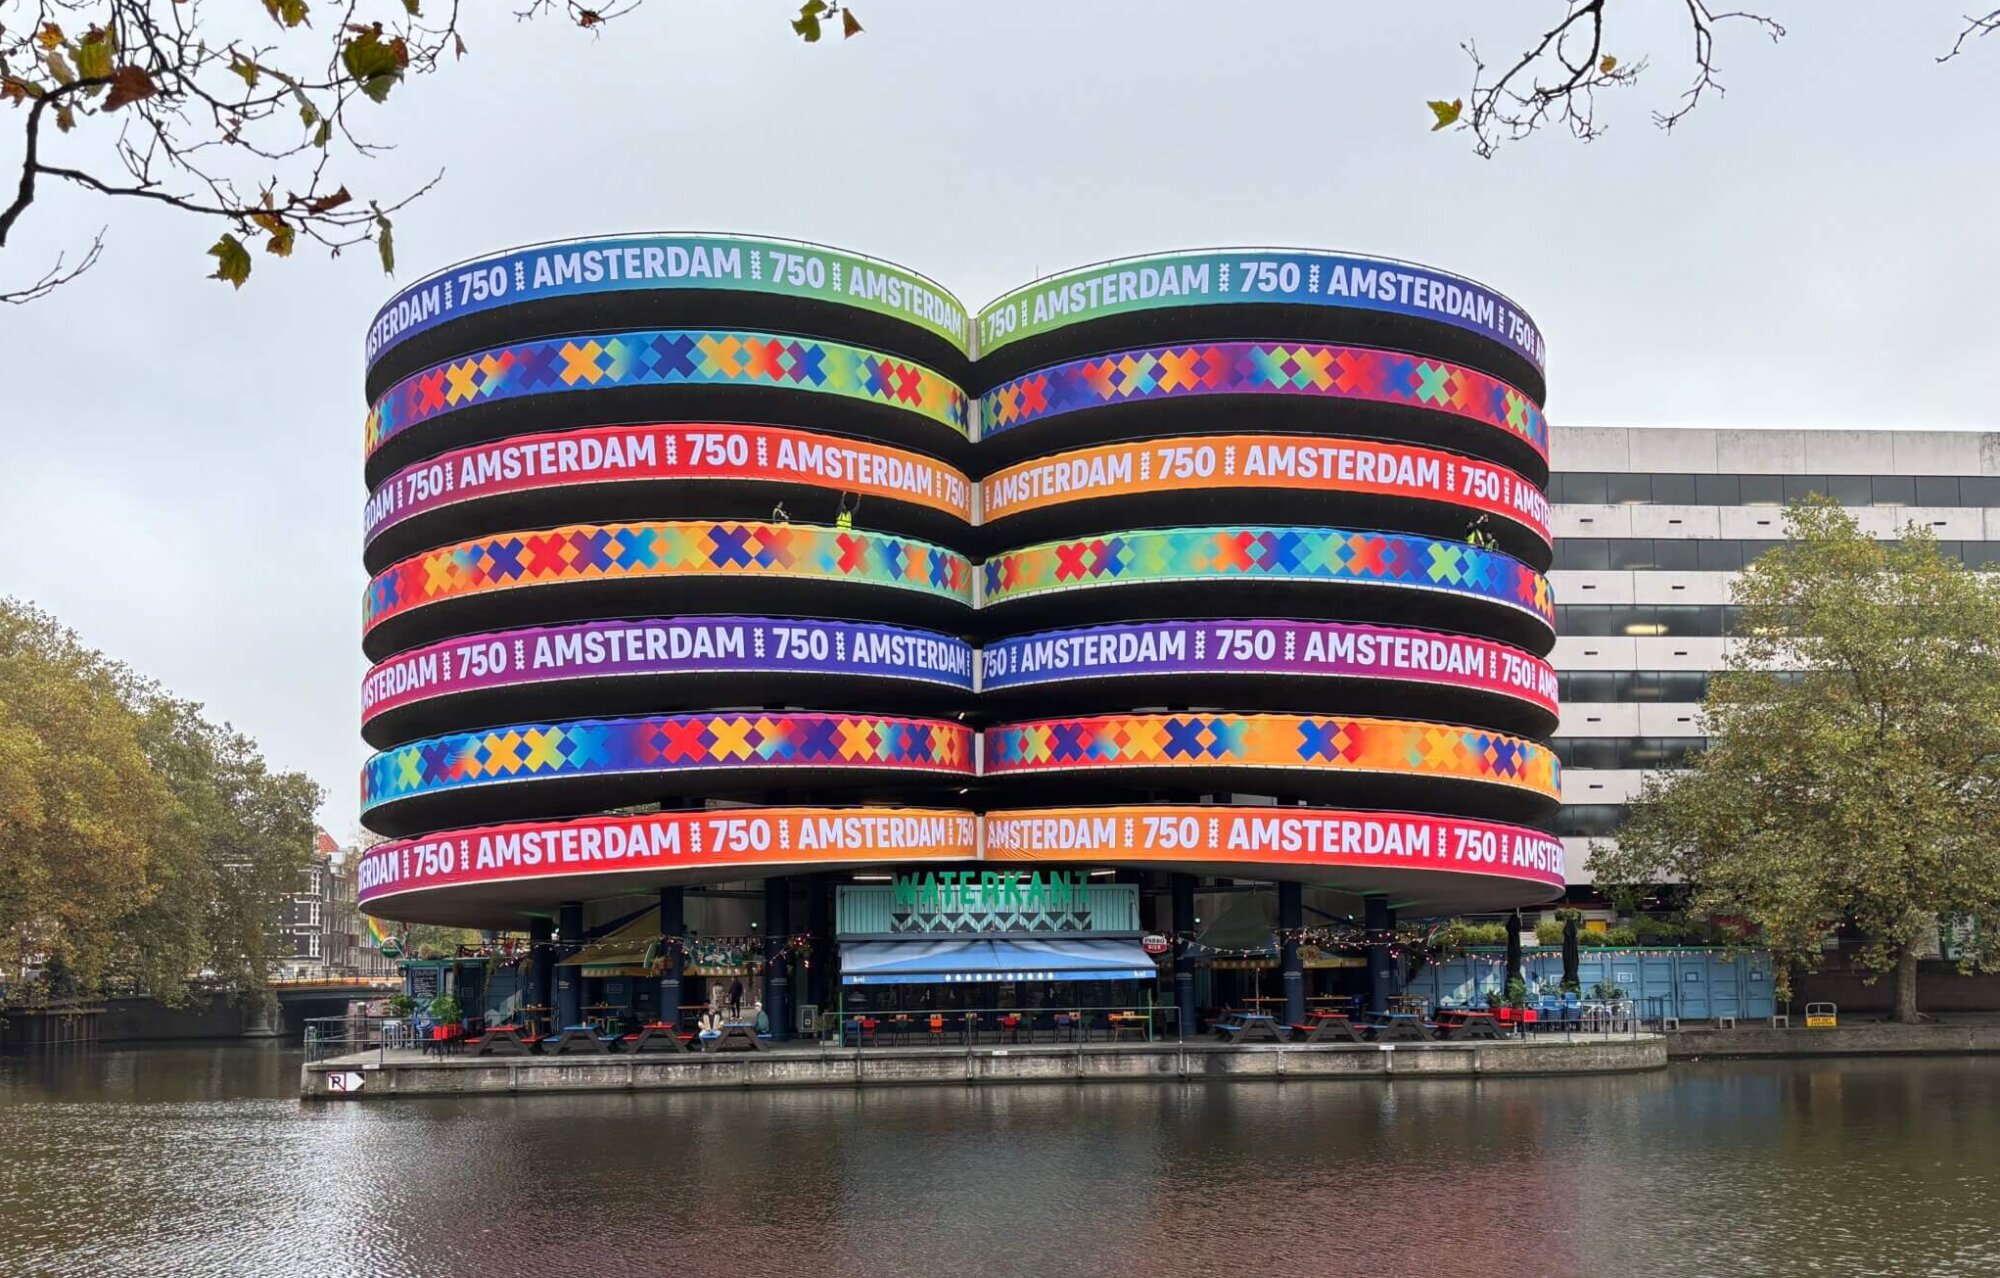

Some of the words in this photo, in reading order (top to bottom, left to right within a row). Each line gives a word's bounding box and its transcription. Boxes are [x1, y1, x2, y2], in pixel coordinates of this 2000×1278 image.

[458, 265, 508, 306] 750
[533, 246, 742, 289] AMSTERDAM
[769, 251, 825, 290] 750
[849, 266, 962, 340] AMSTERDAM
[987, 303, 1017, 343] 750
[1033, 263, 1209, 324] AMSTERDAM
[1240, 262, 1300, 293] 750
[1327, 264, 1494, 330] AMSTERDAM
[1508, 310, 1532, 352] 750
[407, 465, 444, 505] 750
[460, 435, 656, 490] AMSTERDAM
[688, 434, 749, 466] 750
[776, 438, 932, 496] AMSTERDAM
[944, 473, 964, 509] 750
[993, 451, 1132, 510] AMSTERDAM
[1158, 445, 1216, 480] 750
[1243, 445, 1440, 490] AMSTERDAM
[1461, 465, 1500, 501] 750
[457, 642, 507, 679] 750
[533, 627, 745, 670] AMSTERDAM
[772, 628, 829, 661] 750
[852, 632, 965, 676] AMSTERDAM
[983, 647, 1007, 680] 750
[1020, 630, 1186, 673] AMSTERDAM
[1215, 629, 1276, 661] 750
[1304, 631, 1484, 678] AMSTERDAM
[1501, 651, 1531, 689] 750
[413, 841, 454, 878] 750
[476, 822, 680, 868] AMSTERDAM
[709, 818, 771, 852] 750
[798, 817, 945, 850] AMSTERDAM
[956, 817, 974, 847] 750
[987, 817, 1116, 850] AMSTERDAM
[1142, 816, 1200, 849] 750
[1227, 817, 1430, 858] AMSTERDAM
[1454, 830, 1497, 863] 750
[892, 870, 1090, 906] WATERKANT
